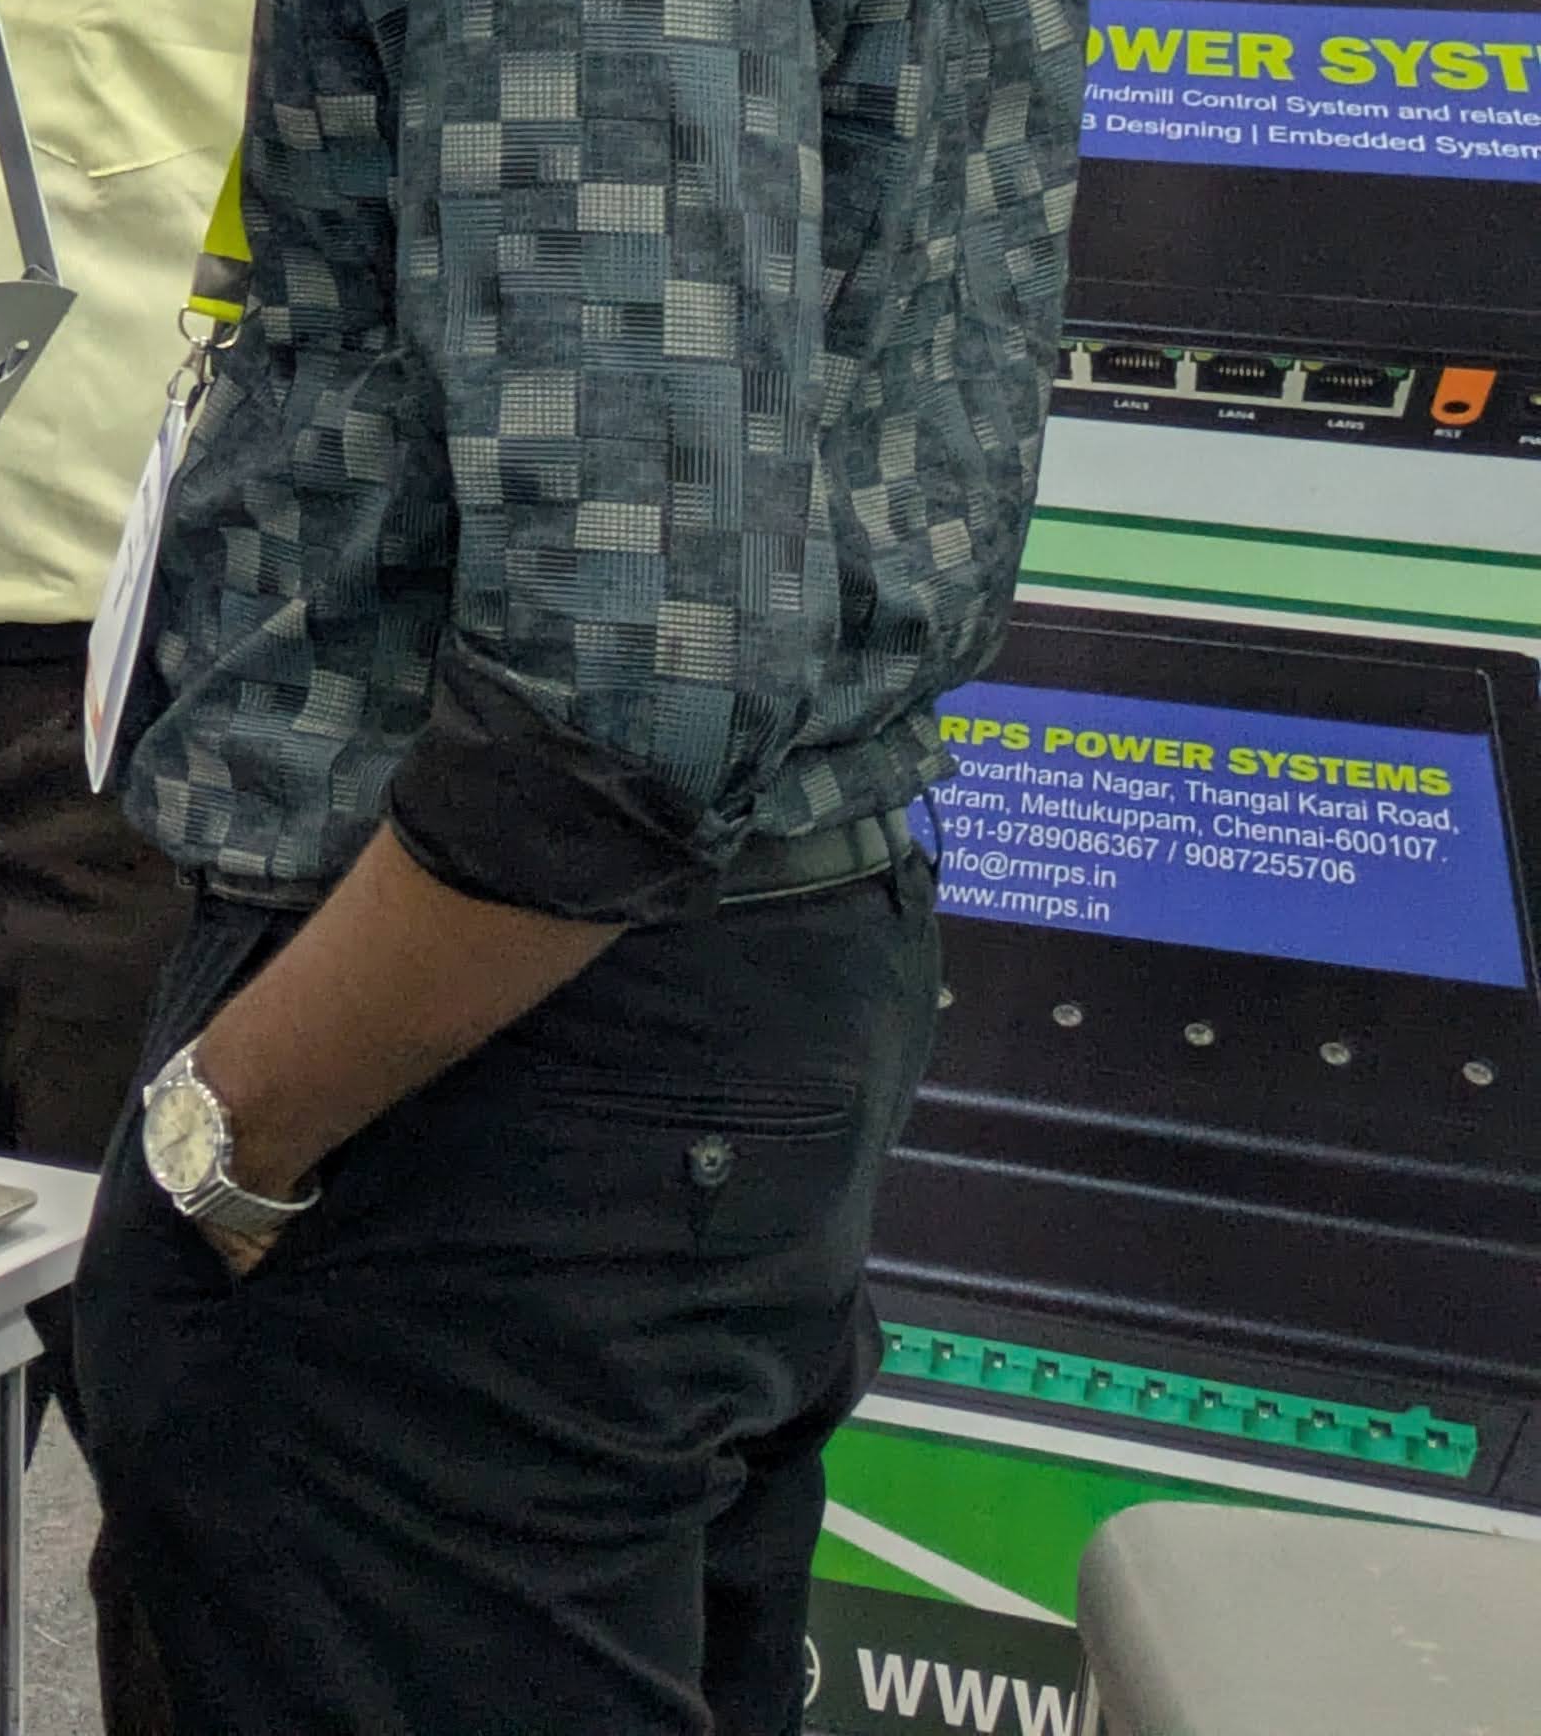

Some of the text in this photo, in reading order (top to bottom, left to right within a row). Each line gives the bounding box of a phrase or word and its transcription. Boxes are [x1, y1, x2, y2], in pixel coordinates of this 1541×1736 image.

[1319, 35, 1541, 94] SYST
[1085, 83, 1174, 106] indmill
[1182, 88, 1278, 113] Control
[1286, 95, 1390, 124] System
[1398, 103, 1451, 123] and
[1105, 114, 1242, 145] Designing
[1268, 124, 1427, 155] Embedded
[939, 716, 1454, 798] RPS POWER SYSTEMS
[929, 782, 1011, 816] ndram,
[1020, 793, 1203, 837] Mettukuppam,
[949, 754, 1461, 834] ovarthana Nagar, Thangal Karai Road,
[939, 850, 1117, 890] nfo@rmrps.in
[940, 815, 1161, 862] +91-9789086367
[1184, 842, 1357, 886] 9087255706
